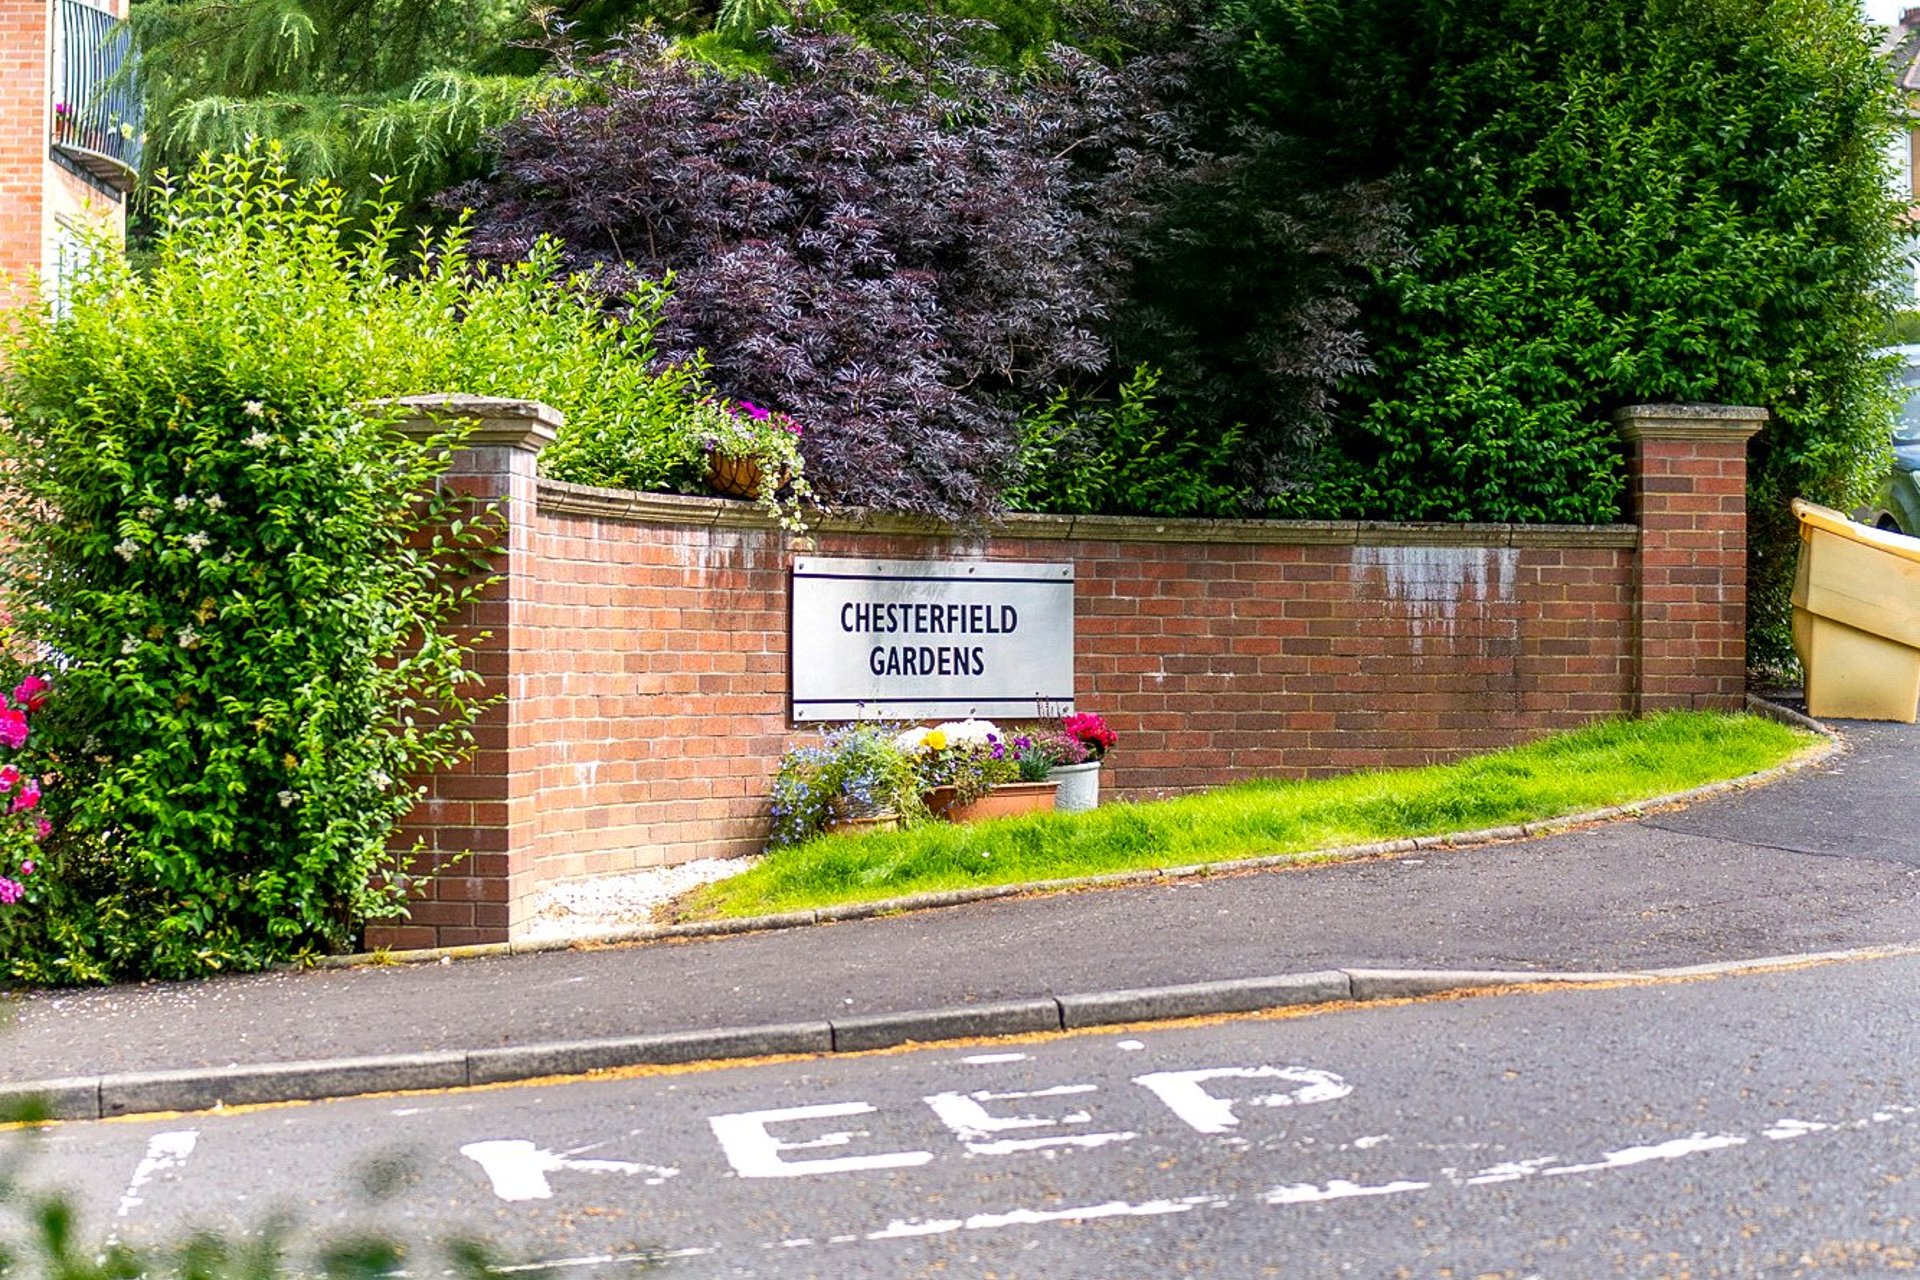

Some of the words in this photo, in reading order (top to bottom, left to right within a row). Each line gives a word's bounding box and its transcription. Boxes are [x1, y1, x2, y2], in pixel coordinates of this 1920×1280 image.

[841, 602, 1018, 633] CHESTERFIELD
[869, 646, 985, 676] GARDENS
[460, 1065, 1353, 1201] KEEP
